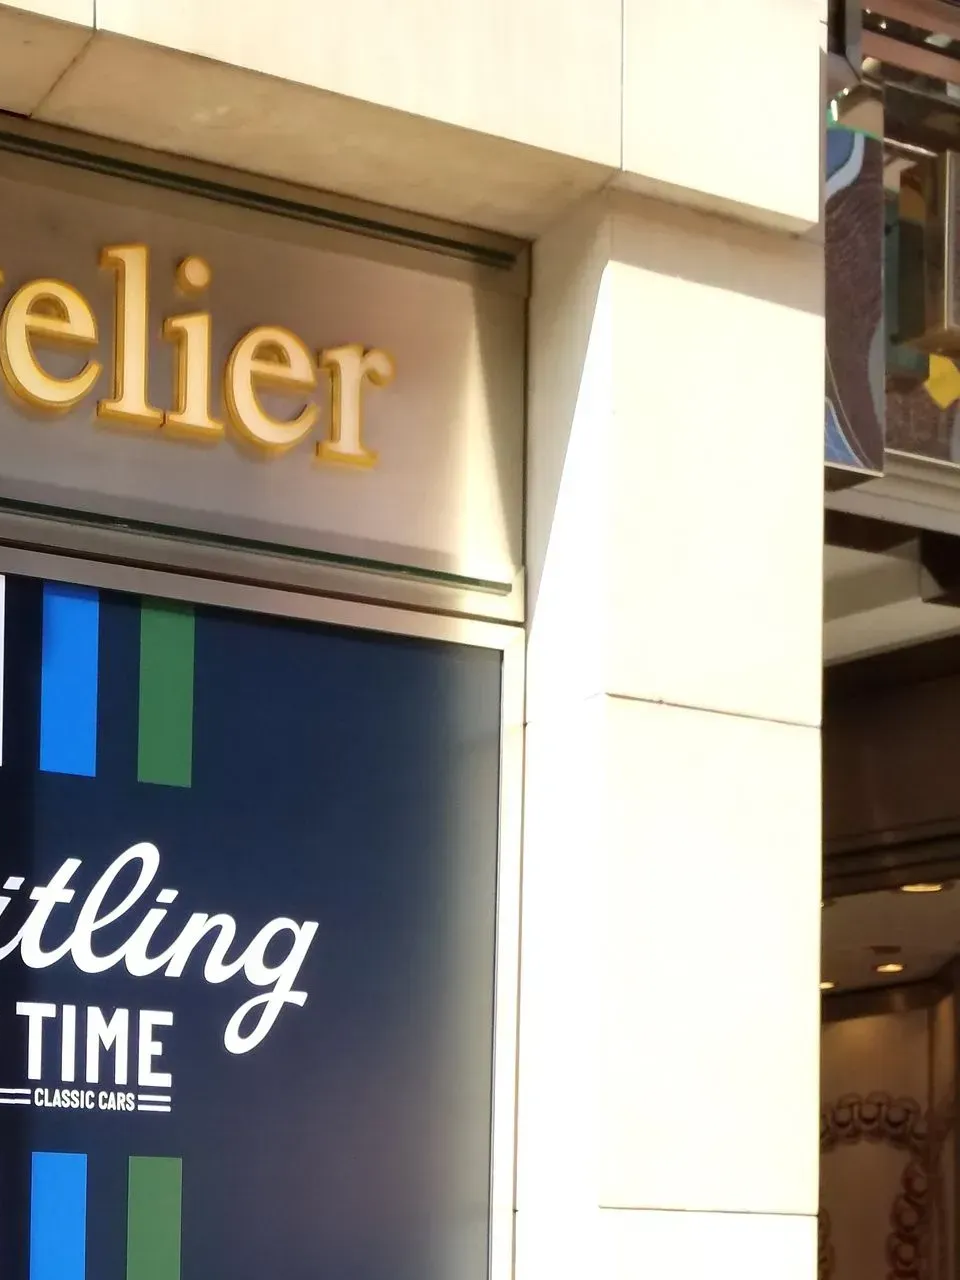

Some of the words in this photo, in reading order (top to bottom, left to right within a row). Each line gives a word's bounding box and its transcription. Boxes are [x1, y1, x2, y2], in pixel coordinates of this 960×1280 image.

[15, 1001, 174, 1087] TIME
[34, 1087, 95, 1109] CLASSIC
[98, 1090, 136, 1111] CARS
